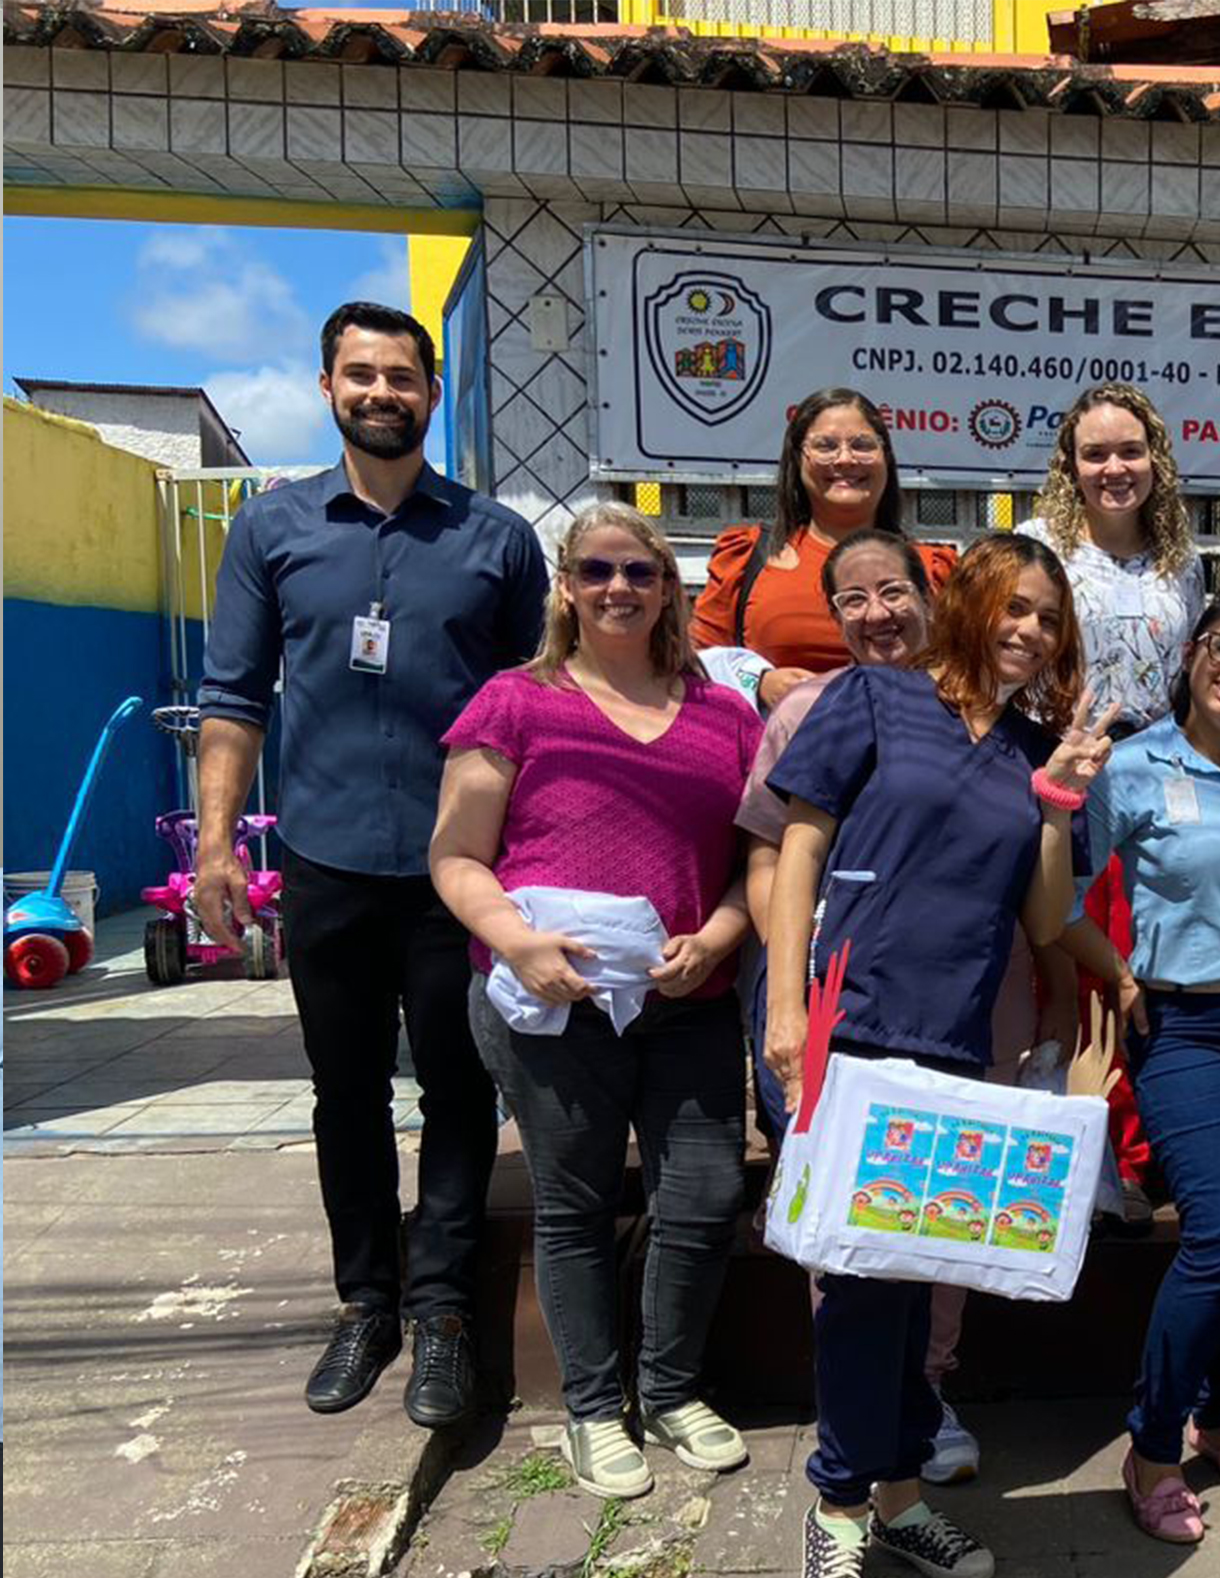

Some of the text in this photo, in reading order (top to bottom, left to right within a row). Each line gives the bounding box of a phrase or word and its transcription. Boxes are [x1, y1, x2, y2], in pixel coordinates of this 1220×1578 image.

[815, 285, 1153, 337] CRECHE
[852, 347, 923, 373] CNPJ.
[933, 351, 1190, 384] 02.140.460/0001-40
